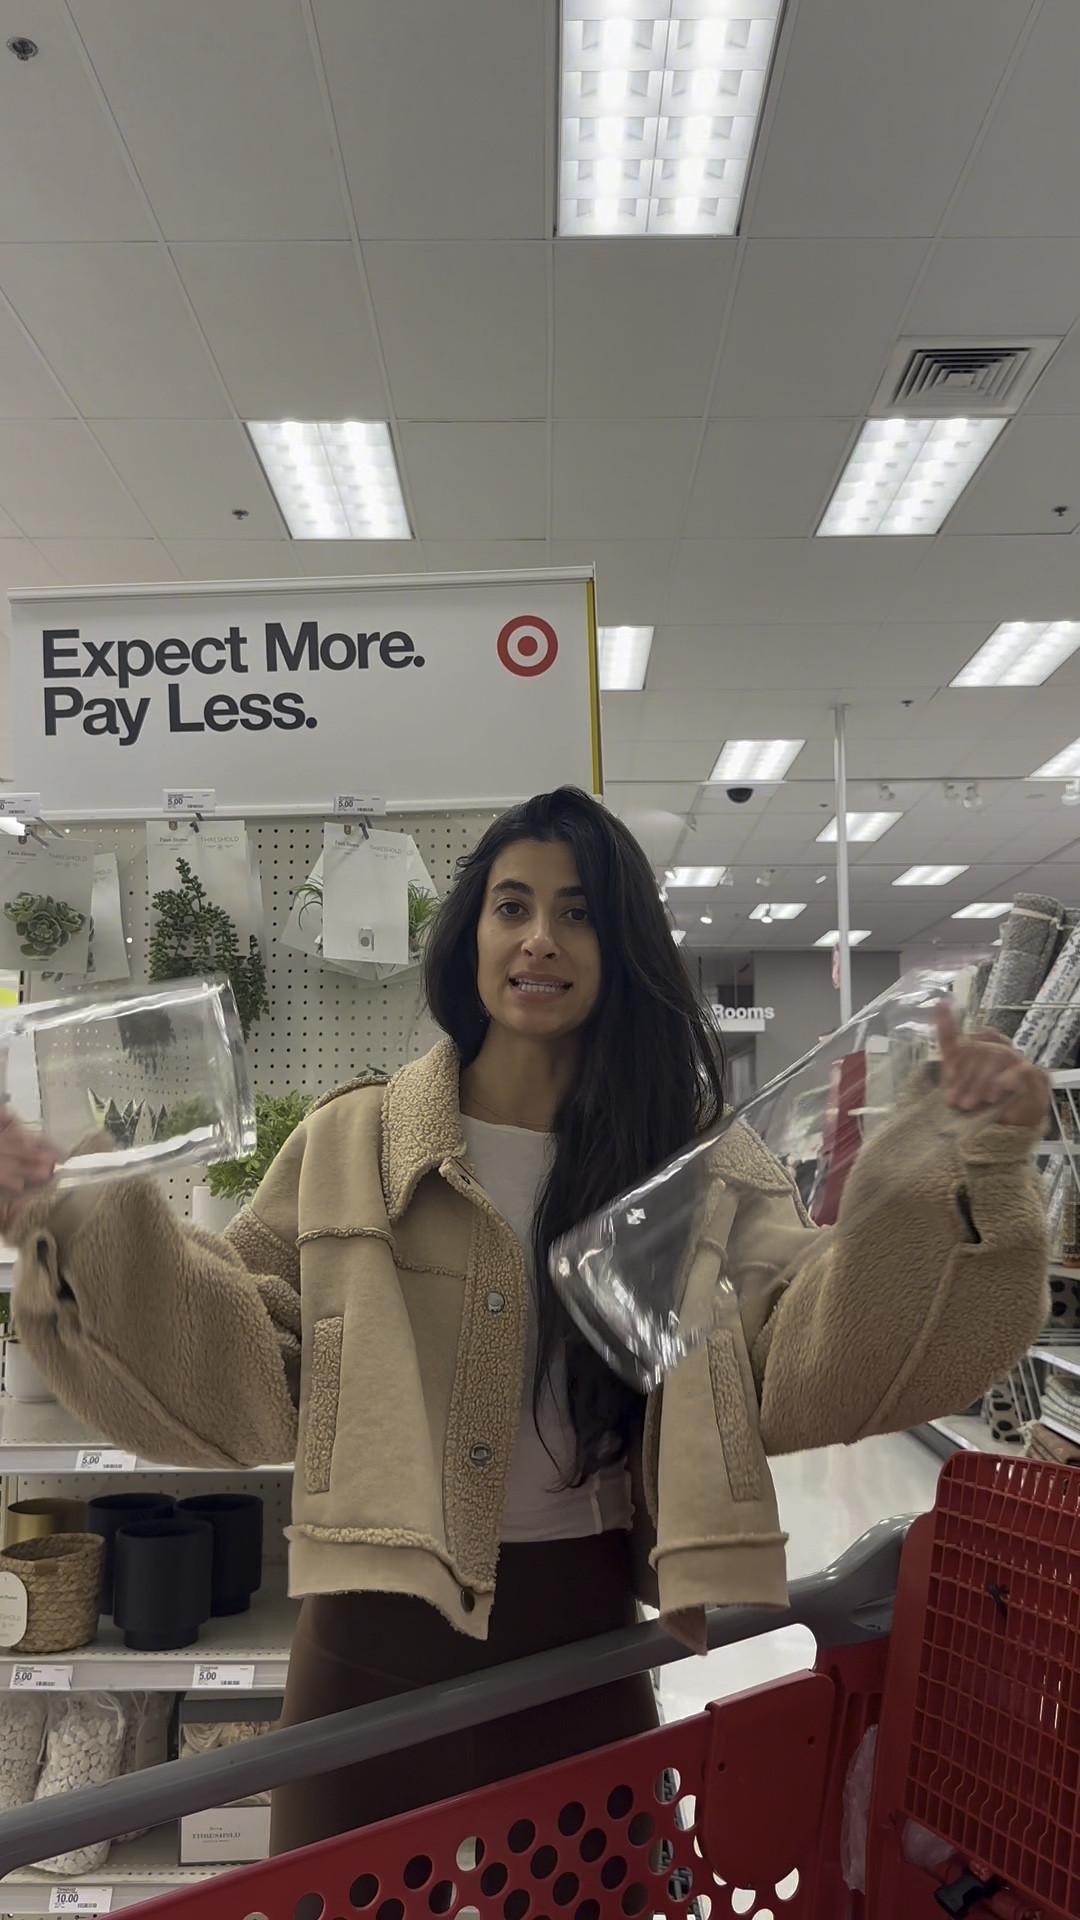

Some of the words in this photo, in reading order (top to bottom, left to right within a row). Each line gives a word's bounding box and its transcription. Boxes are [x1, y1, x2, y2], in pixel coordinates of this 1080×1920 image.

[42, 627, 248, 688] Expect
[265, 621, 425, 672] More.
[44, 686, 151, 746] Pay
[168, 683, 318, 732] Less.
[338, 800, 354, 808] 5.00
[711, 1003, 775, 1019] Rooms
[82, 1456, 99, 1464] 5.00
[15, 1671, 32, 1680] 5.00
[199, 1671, 217, 1680] 5.00
[56, 1893, 79, 1903] 10.00
